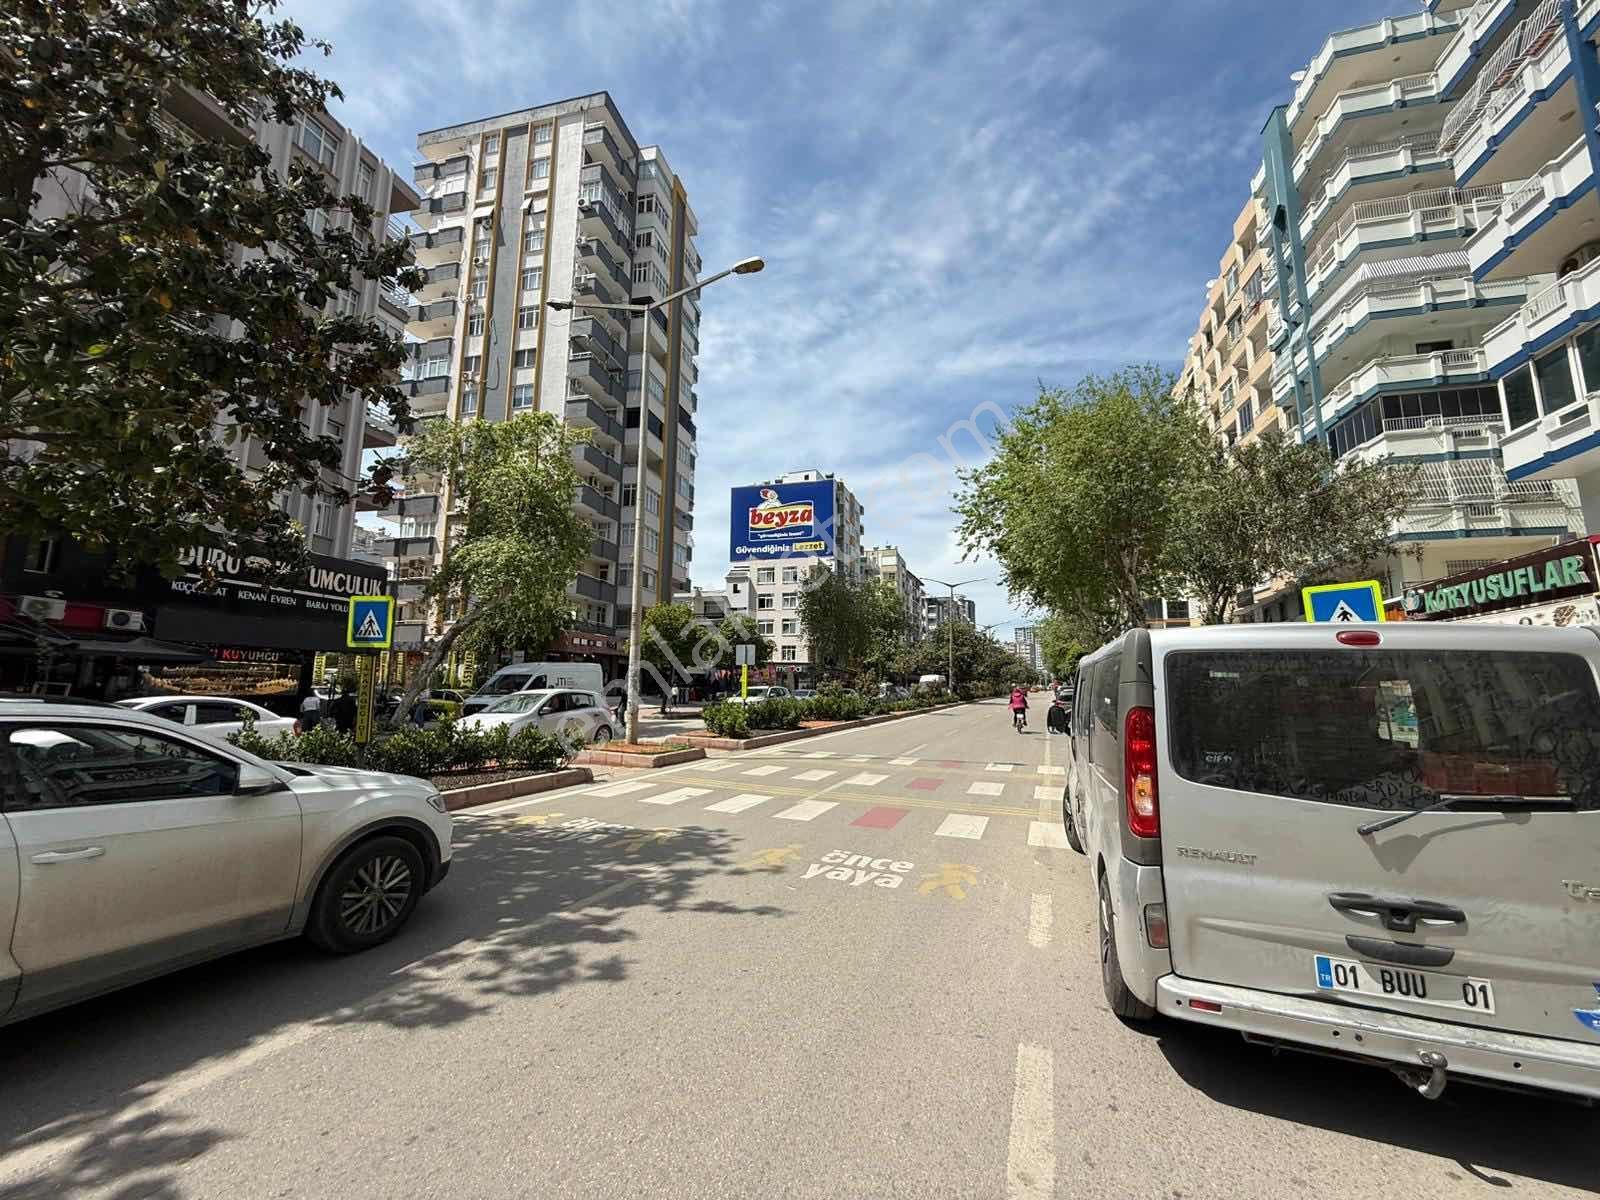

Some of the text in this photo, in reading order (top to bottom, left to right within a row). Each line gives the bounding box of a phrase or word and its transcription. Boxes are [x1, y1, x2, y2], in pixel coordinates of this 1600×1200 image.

[750, 507, 812, 528] beyza
[178, 545, 241, 575] DURU
[735, 542, 824, 554] Güvendiğiniz Lezzet
[1424, 555, 1589, 614] KÖRYUSUFLAR
[238, 590, 268, 602] KENAN
[305, 599, 329, 611] BARAJ
[821, 849, 914, 873] önce
[1176, 846, 1258, 866] RENAULT
[800, 863, 904, 888] yaya
[1334, 963, 1490, 1009] 01 BUU 01
